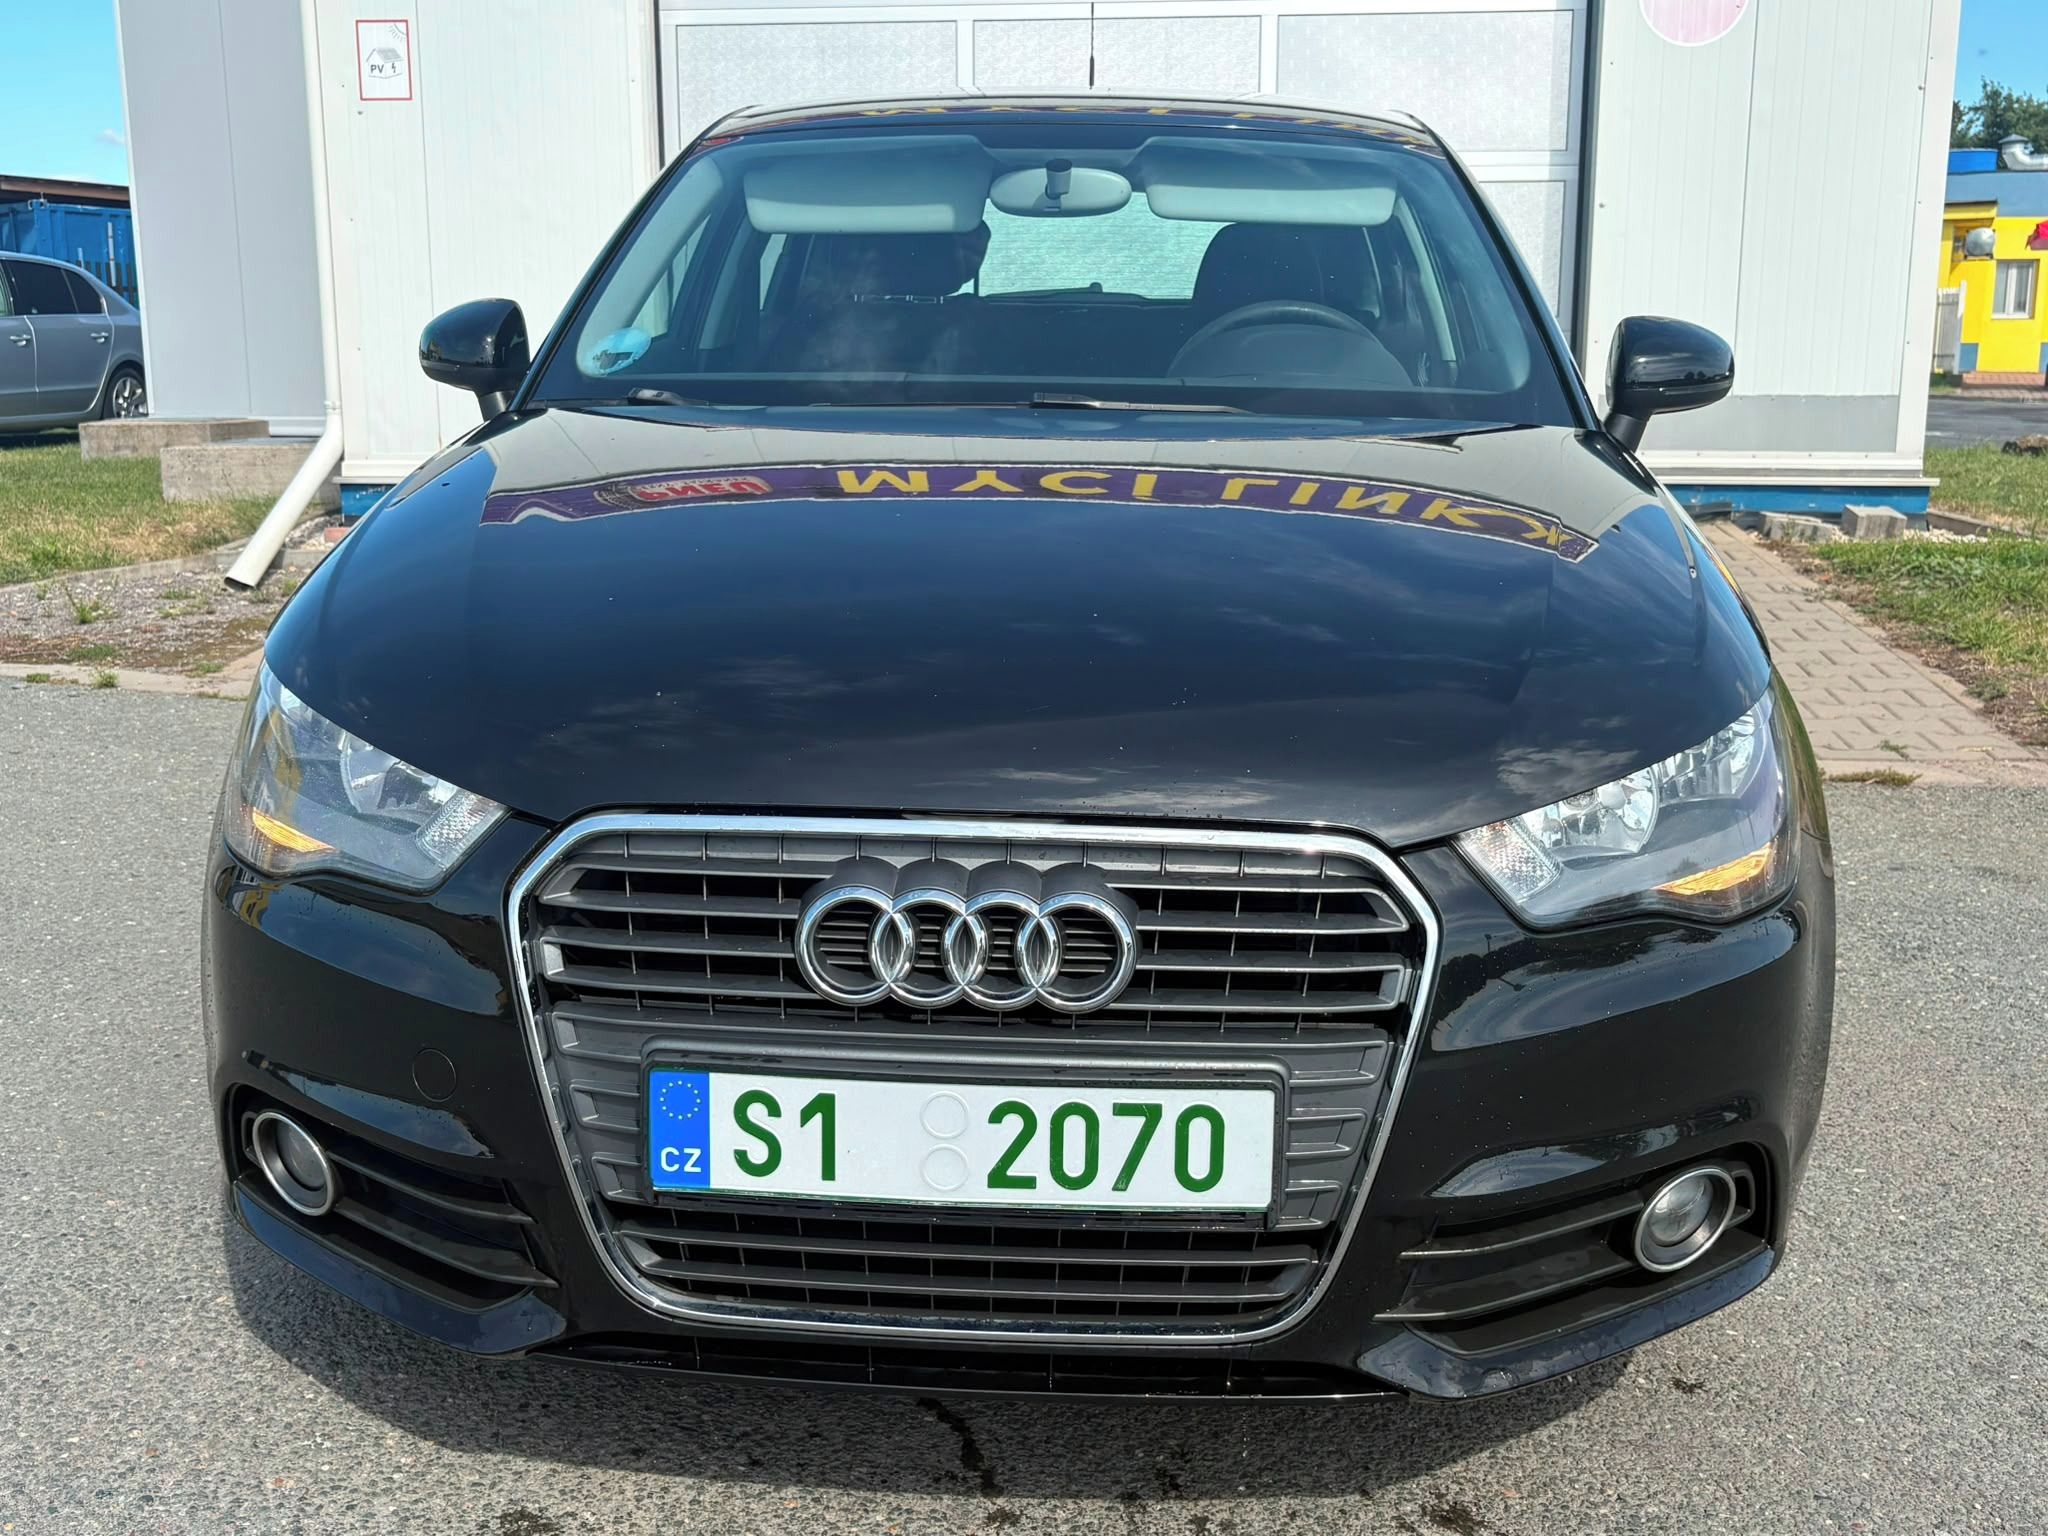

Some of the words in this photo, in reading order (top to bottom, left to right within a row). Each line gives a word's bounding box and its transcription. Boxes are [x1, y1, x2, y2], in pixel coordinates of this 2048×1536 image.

[370, 64, 384, 73] PV
[732, 1089, 836, 1182] S1
[986, 1100, 1225, 1192] 2070
[660, 1146, 703, 1173] CZ
